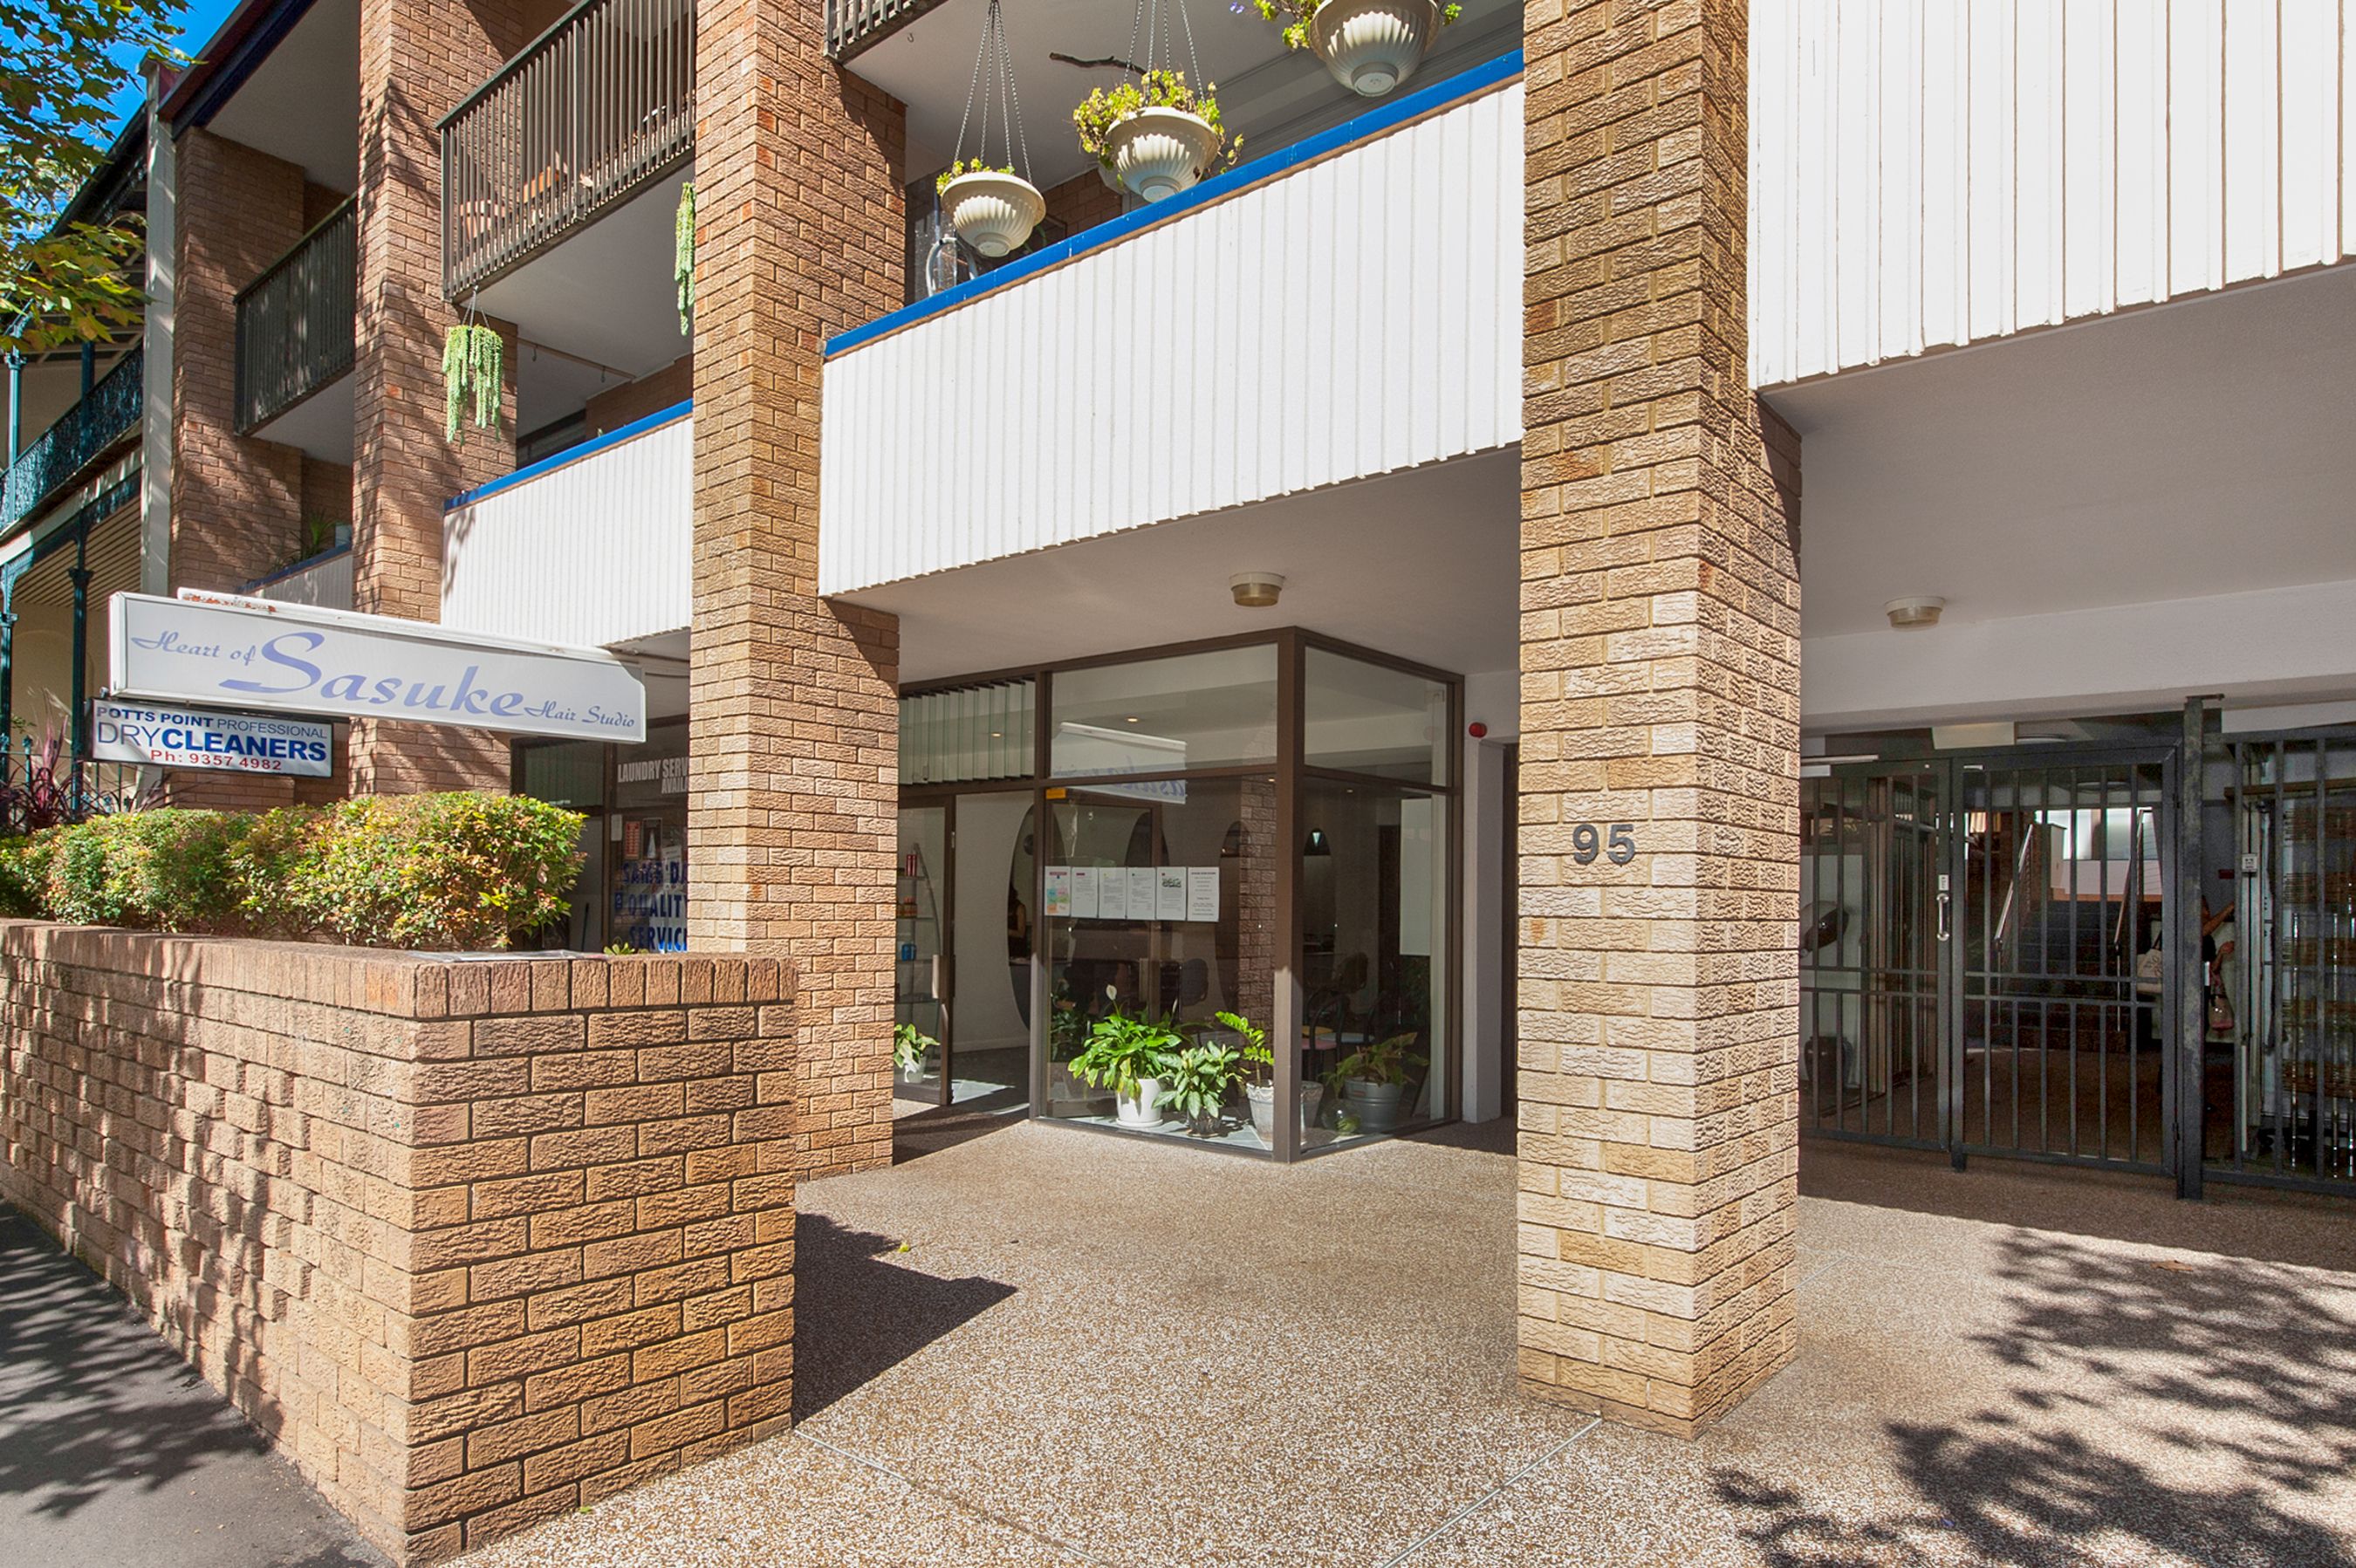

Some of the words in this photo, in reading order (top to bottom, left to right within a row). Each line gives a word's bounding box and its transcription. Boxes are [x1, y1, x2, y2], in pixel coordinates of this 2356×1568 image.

[131, 630, 220, 658] Heart
[229, 645, 256, 666] of
[218, 631, 524, 717] Sasuke
[96, 705, 155, 722] POTTS
[160, 713, 214, 729] POINT
[217, 718, 327, 739] PROFESSIONAL
[524, 700, 576, 722] Hair
[582, 705, 635, 729] Studio
[97, 722, 327, 762] DRYCLEANERS
[150, 750, 182, 763] Ph:
[189, 752, 234, 767] 9357
[239, 757, 282, 770] 4982
[617, 759, 661, 783] LAUNDRY
[1572, 823, 1635, 866] 95
[628, 894, 688, 918] QUALIT
